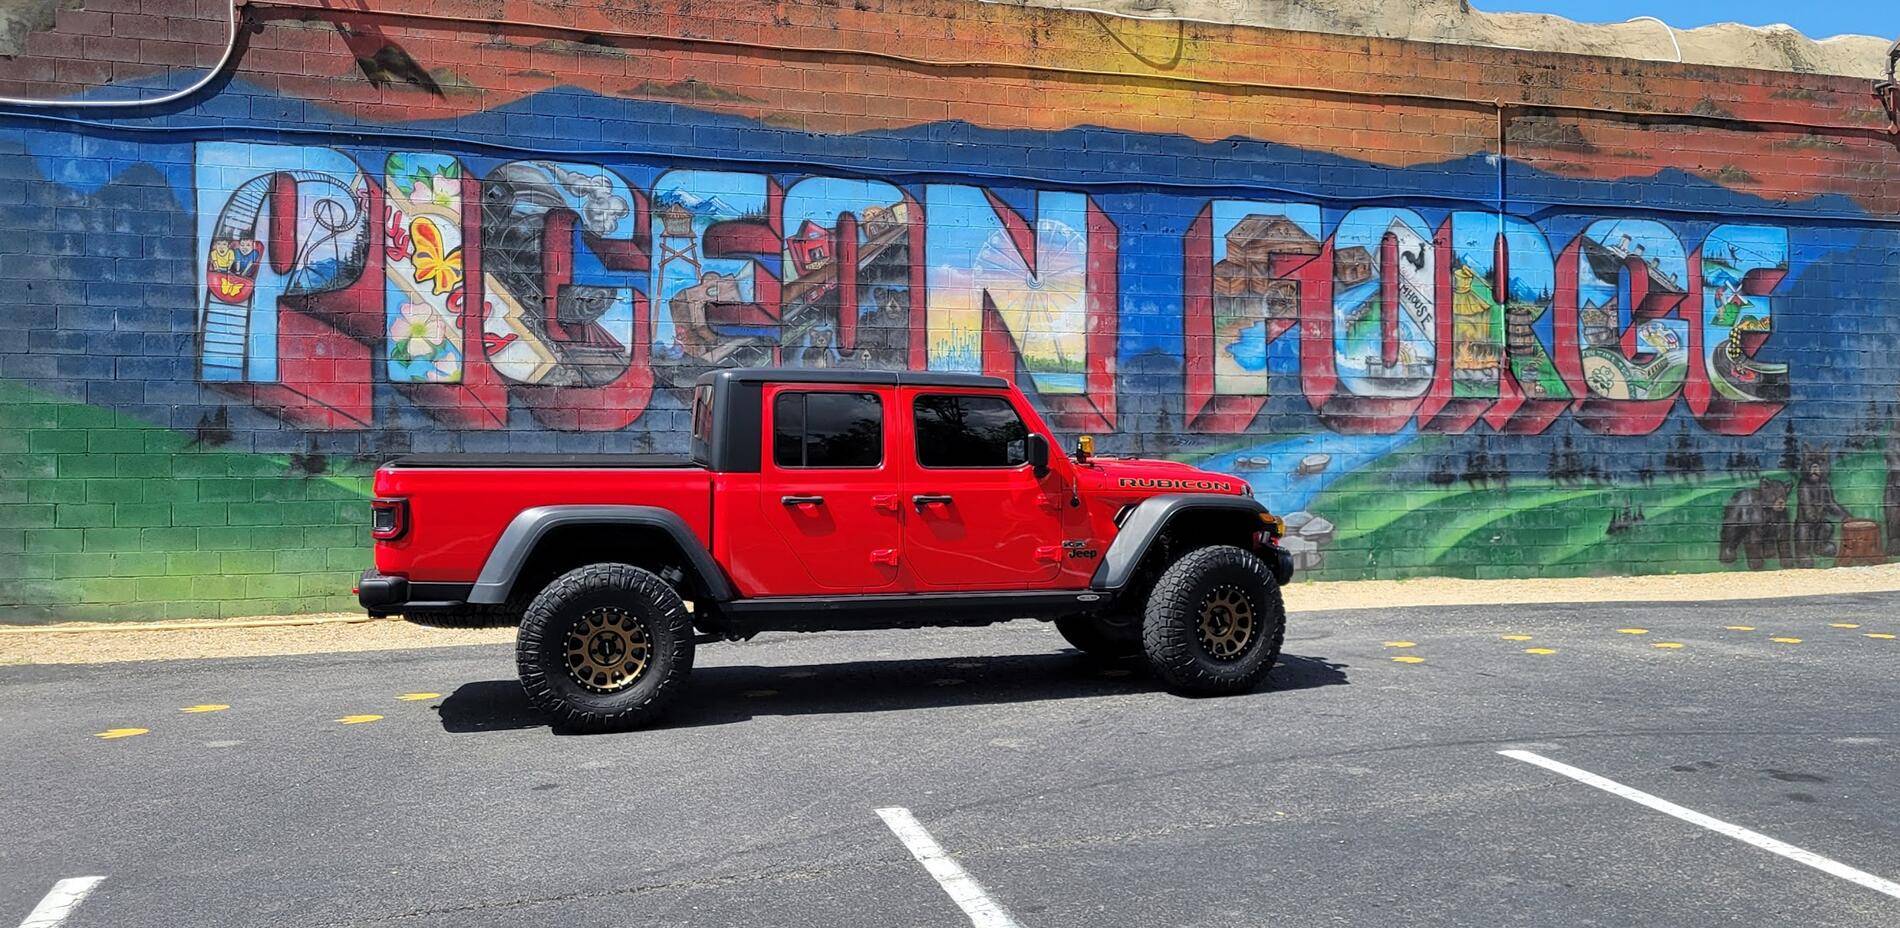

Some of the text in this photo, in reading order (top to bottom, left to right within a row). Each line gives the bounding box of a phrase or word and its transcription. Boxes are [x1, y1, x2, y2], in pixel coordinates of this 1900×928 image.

[195, 142, 1790, 435] PIGEON FORGE
[1119, 477, 1232, 491] RUBICON
[1068, 549, 1097, 559] Jeep
